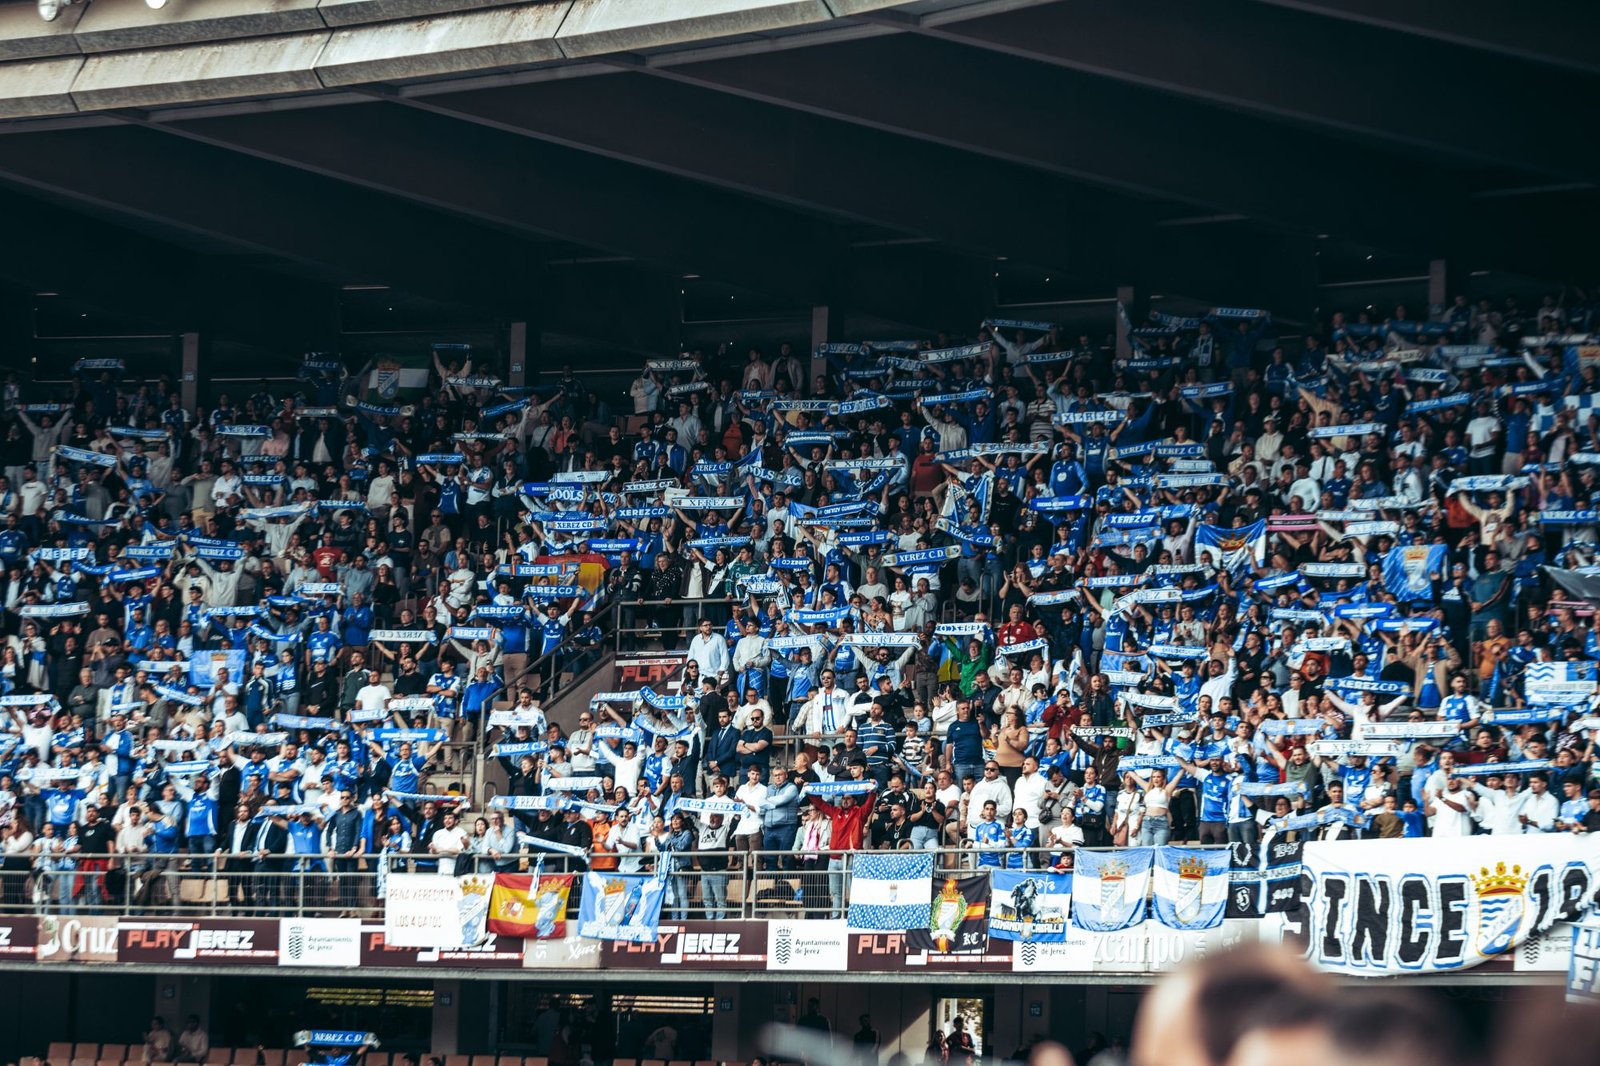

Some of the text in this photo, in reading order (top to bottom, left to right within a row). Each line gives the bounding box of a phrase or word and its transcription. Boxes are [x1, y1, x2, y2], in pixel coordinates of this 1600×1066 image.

[1063, 411, 1116, 423] XEREZ
[1120, 445, 1145, 454] XEREZ
[695, 464, 717, 472] XEREZ
[690, 499, 727, 507] XEREZ
[652, 508, 665, 516] CD
[1111, 514, 1154, 523] XEREZ CD
[557, 521, 580, 529] XEREZ
[42, 548, 88, 560] XEREZ
[899, 553, 925, 563] XEREZ
[519, 566, 545, 574] XEREZ
[1092, 577, 1117, 586] XEREZ
[525, 586, 557, 594] XEREZ
[477, 606, 523, 614] XEREZ CD
[862, 635, 904, 643] XEREZ
[622, 665, 677, 682] PLAY
[1338, 679, 1398, 691] XEREZ CD
[1281, 866, 1468, 969] SINCE
[62, 919, 119, 953] Cruz
[126, 930, 185, 948] PLAY
[795, 938, 840, 948] Ayuntamiento
[804, 947, 820, 956] Jerez
[314, 1032, 343, 1041] XEREZ
